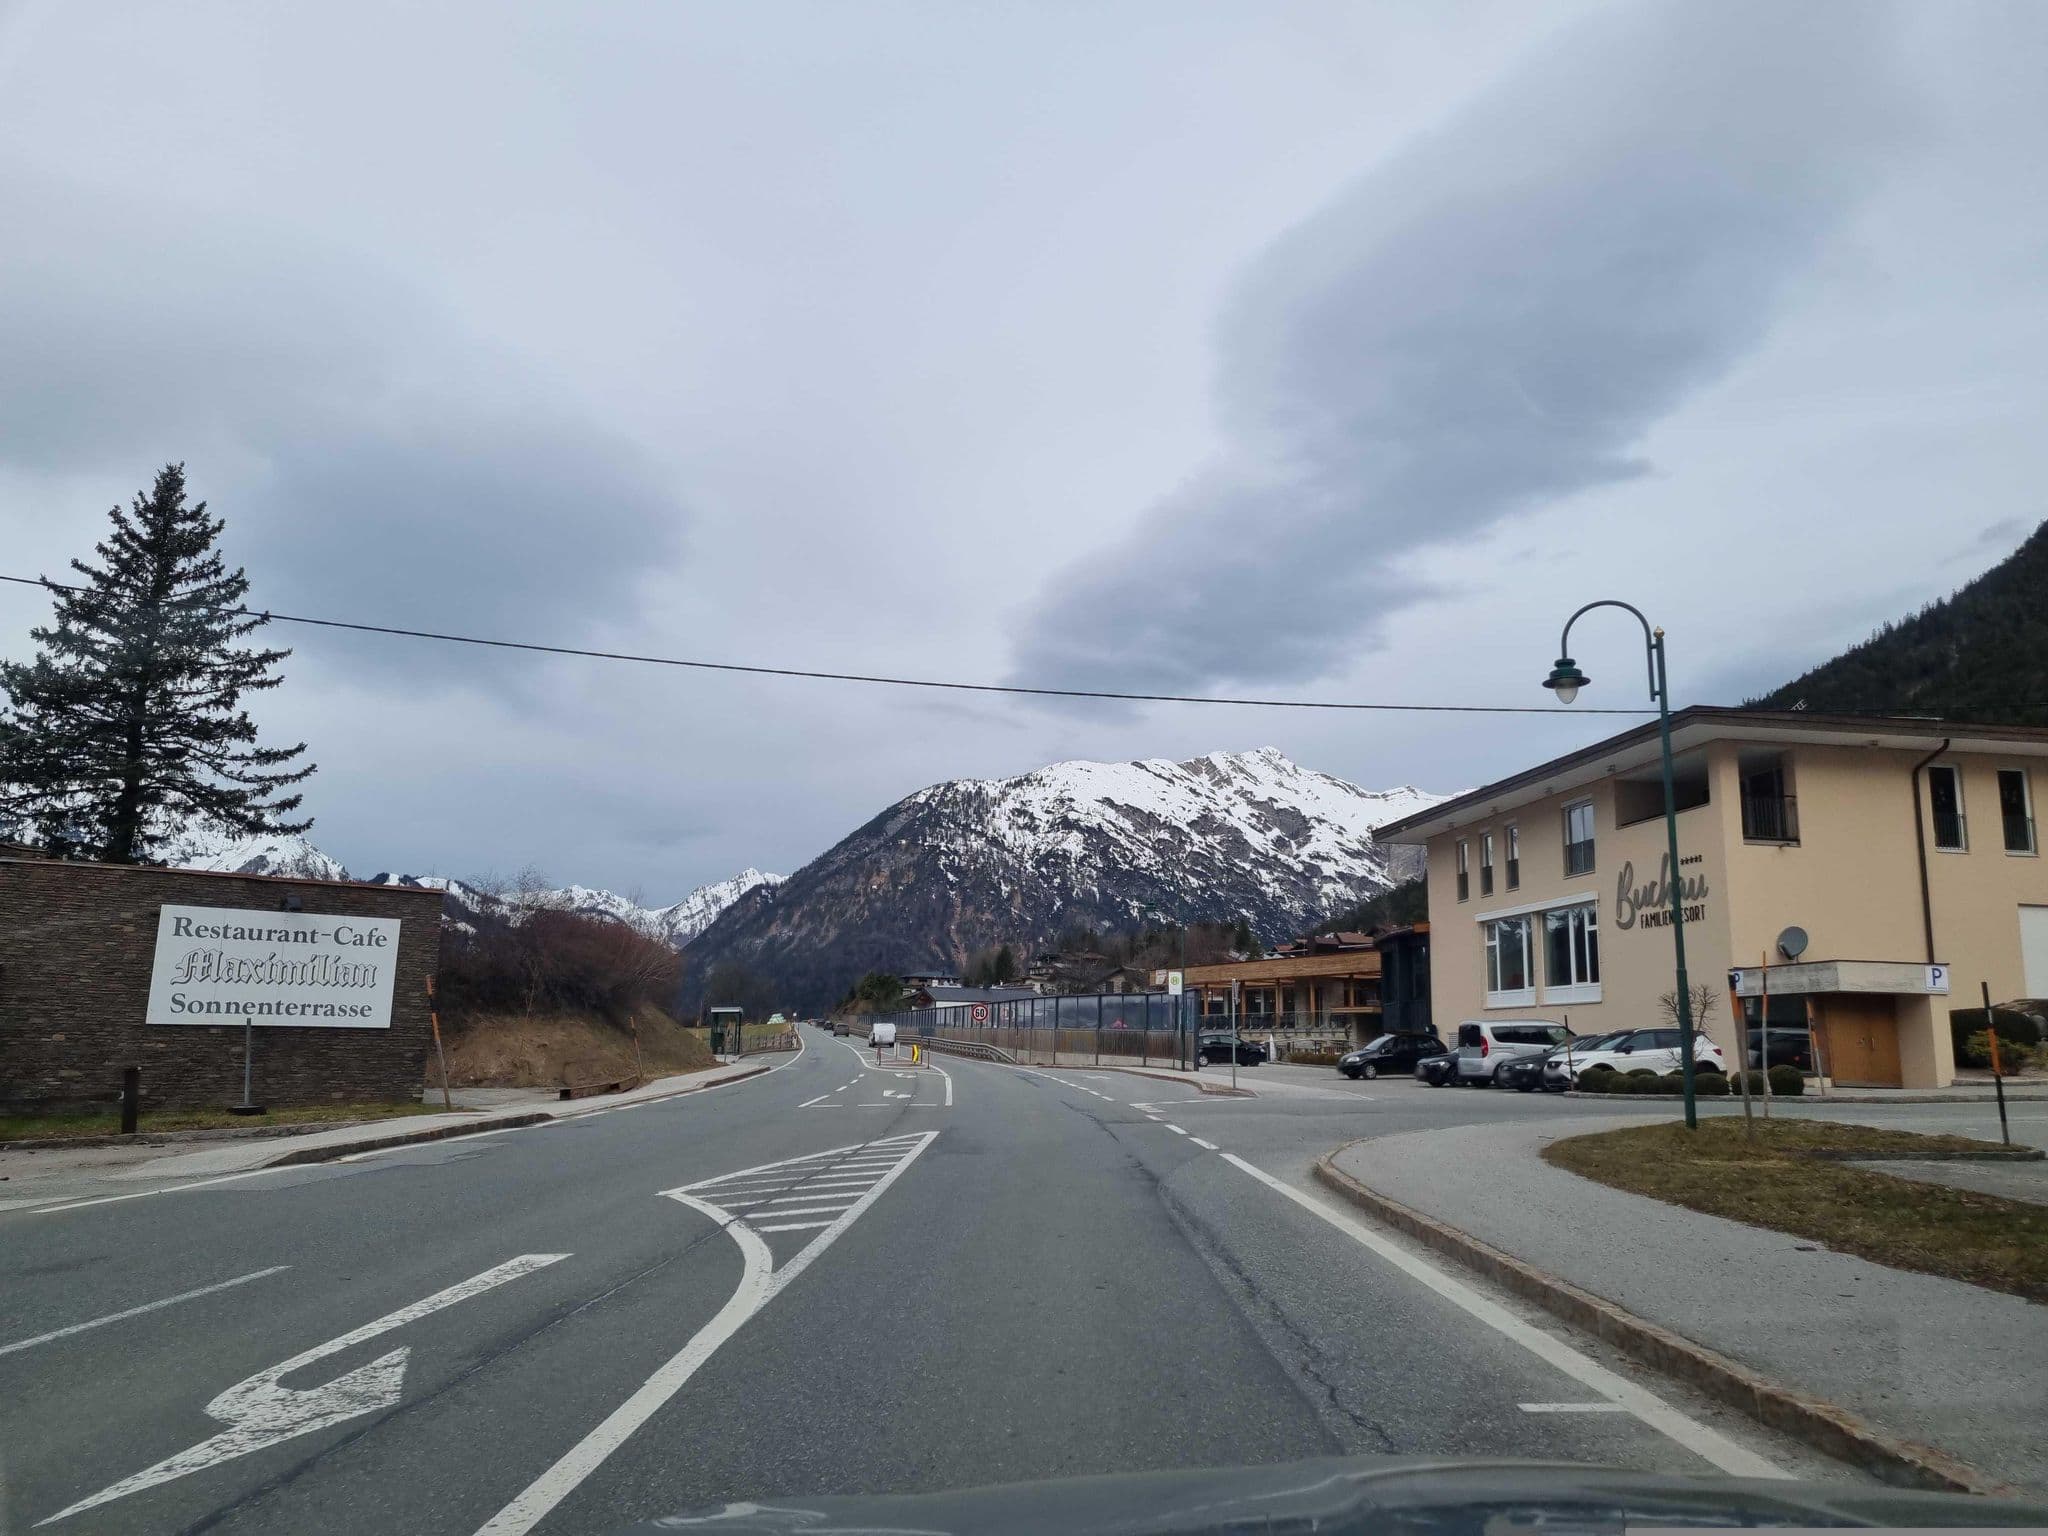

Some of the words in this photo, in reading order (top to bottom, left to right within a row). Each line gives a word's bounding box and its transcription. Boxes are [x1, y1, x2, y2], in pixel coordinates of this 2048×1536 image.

[1640, 904, 1705, 929] FAMILIENESORT
[172, 916, 388, 948] Restaurant-Cafe
[170, 948, 379, 988] Maximilian
[1931, 967, 1942, 986] P
[170, 992, 373, 1018] Sonnenterrasse
[975, 1008, 985, 1018] 60
